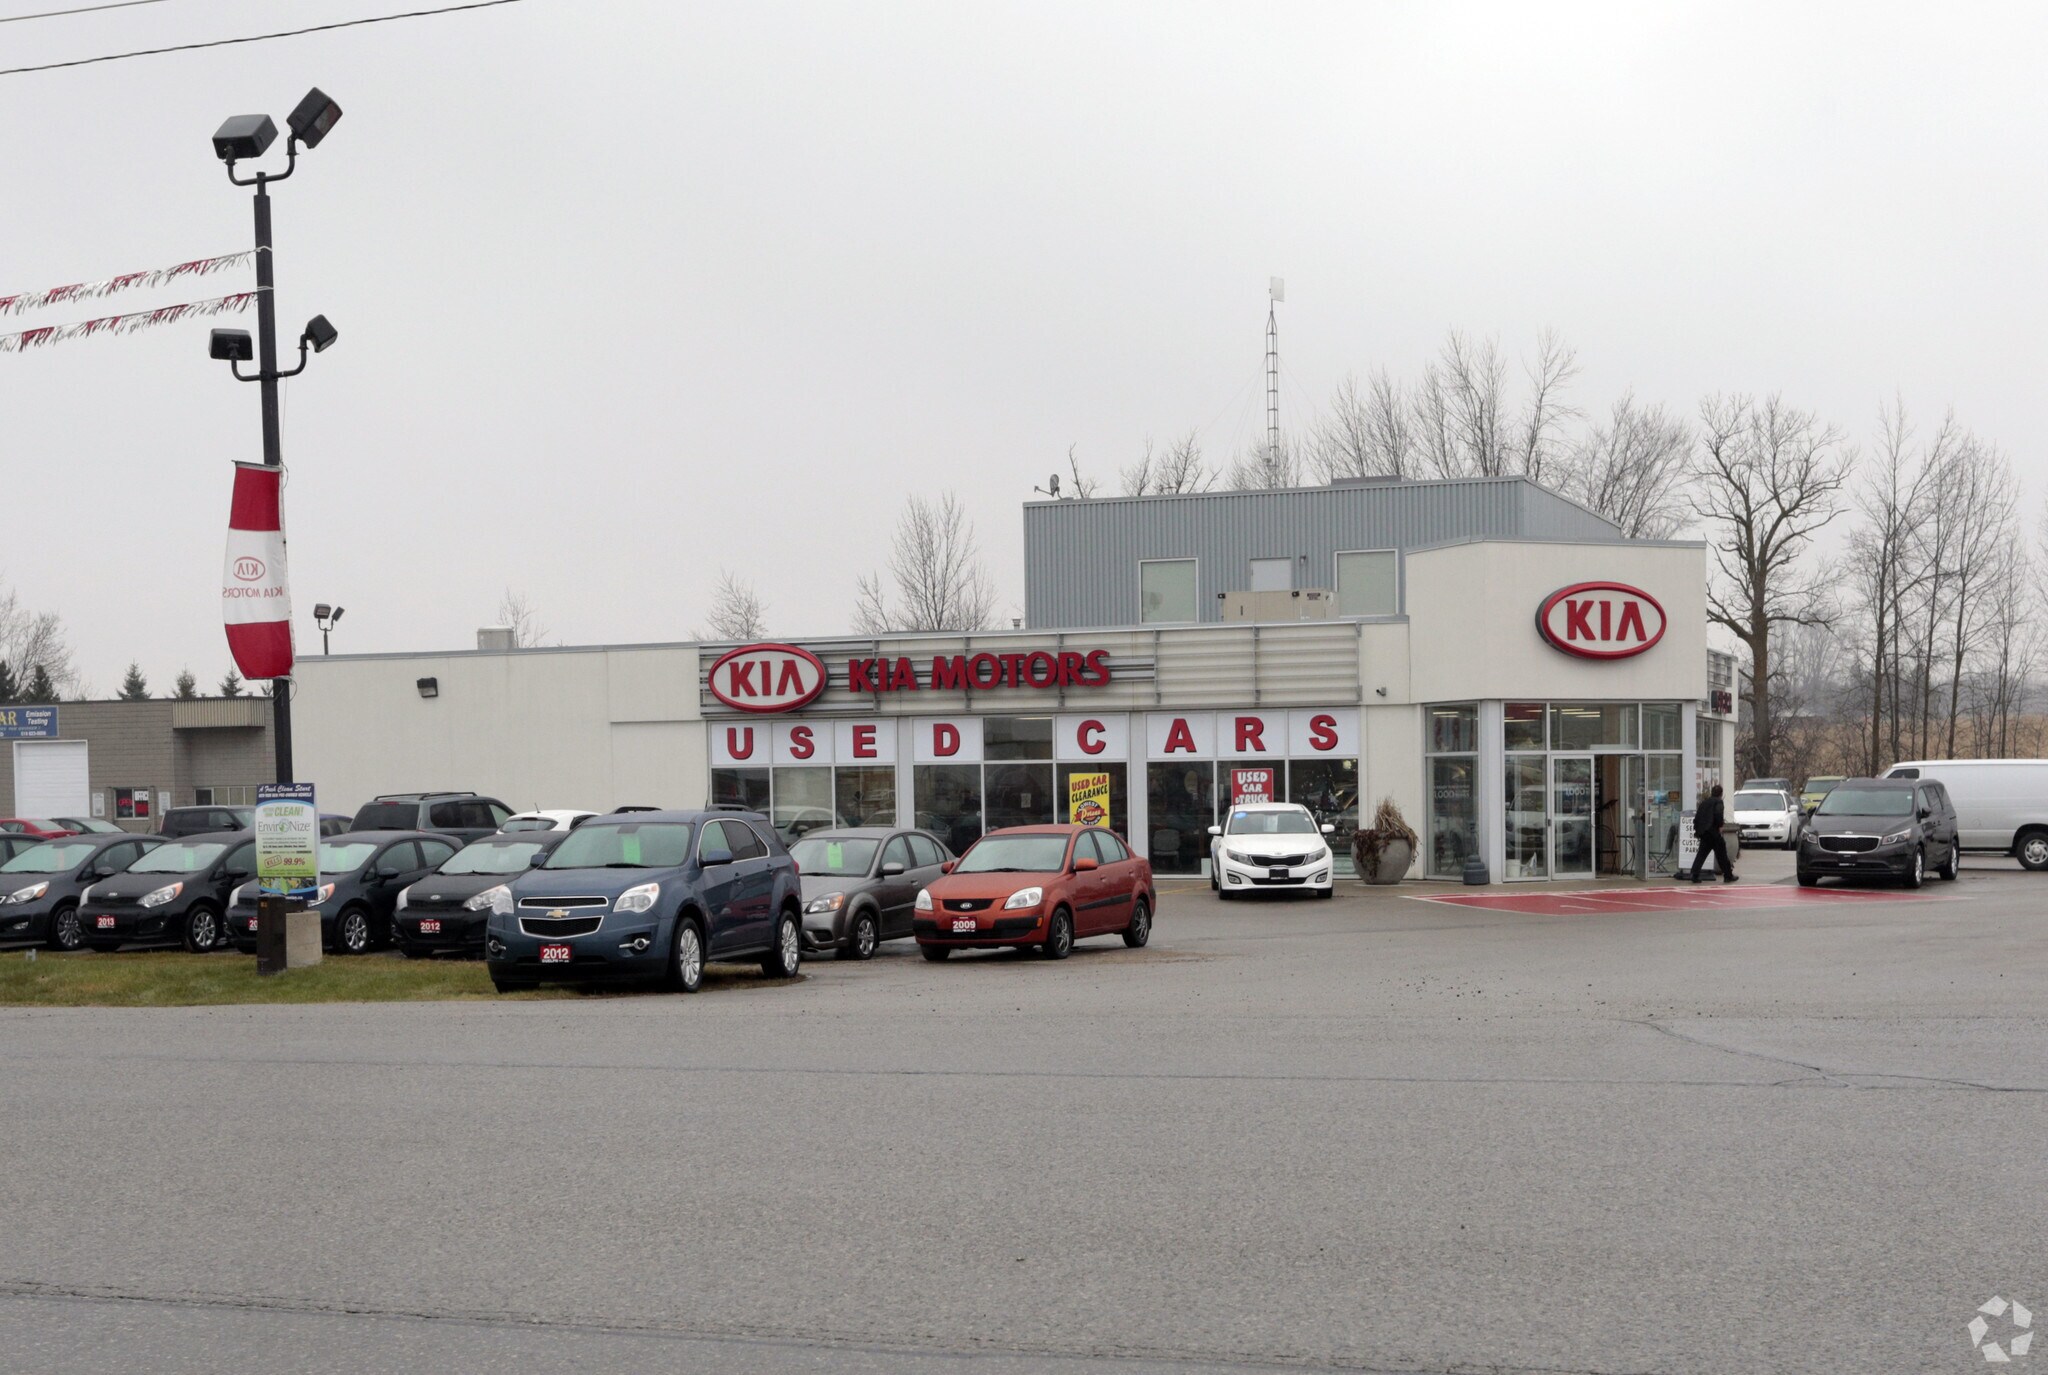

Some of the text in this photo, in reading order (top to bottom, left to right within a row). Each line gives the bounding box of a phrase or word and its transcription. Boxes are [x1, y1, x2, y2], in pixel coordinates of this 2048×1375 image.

[1565, 600, 1647, 641] KIA
[848, 650, 1111, 693] KIA MOTORS
[728, 659, 806, 697] KIA
[26, 710, 51, 718] Emission
[28, 718, 48, 726] Testing
[727, 714, 1339, 760] USED CARS
[1236, 771, 1268, 784] USED
[1071, 775, 1107, 791] USED CAR
[1242, 783, 1263, 792] CAR
[277, 785, 293, 793] Clean
[1071, 785, 1107, 803] CLEARANCE
[1239, 794, 1269, 804] TRUCK
[274, 806, 304, 816] CLEAN!
[1077, 801, 1098, 812] LOWEST
[283, 857, 306, 866] 99.9%
[98, 917, 114, 926] 2013
[249, 919, 258, 928] 20
[420, 922, 440, 930] 2012
[952, 920, 976, 929] 2009
[543, 947, 569, 959] 2012
